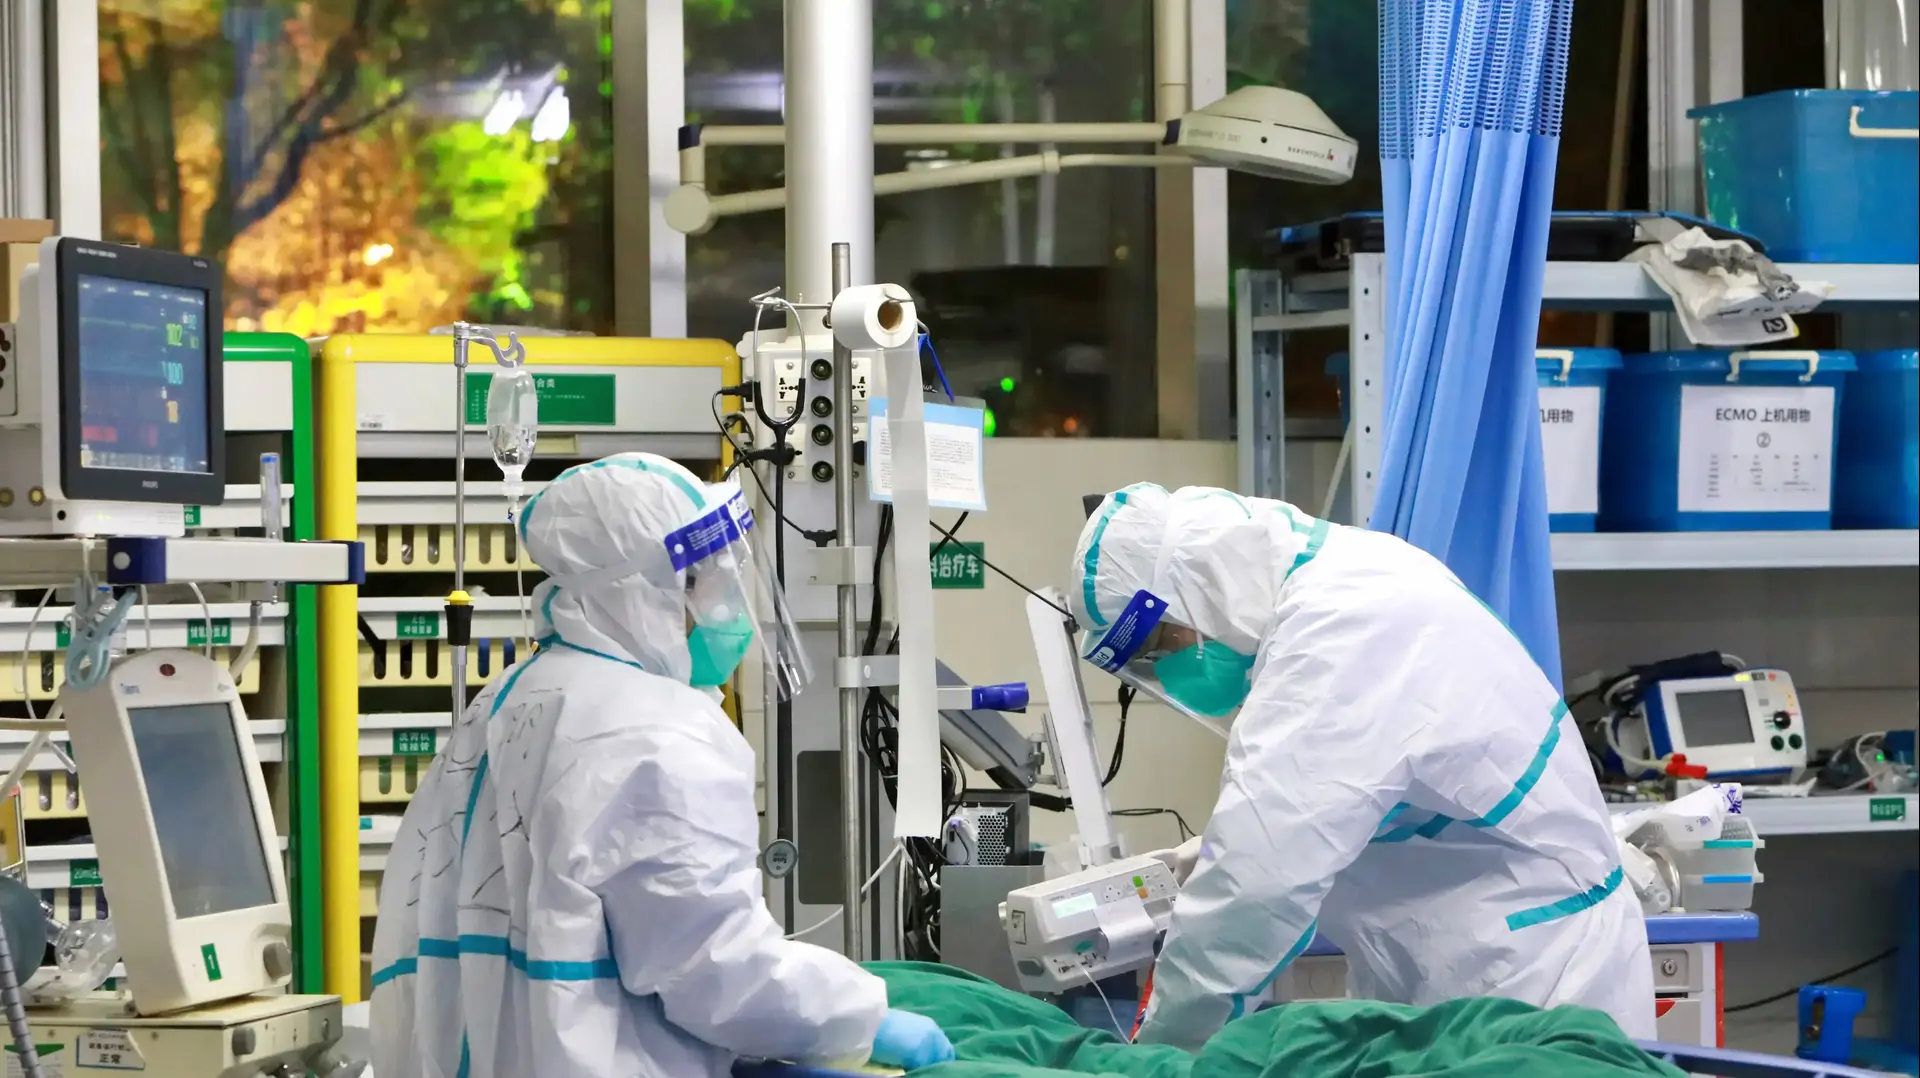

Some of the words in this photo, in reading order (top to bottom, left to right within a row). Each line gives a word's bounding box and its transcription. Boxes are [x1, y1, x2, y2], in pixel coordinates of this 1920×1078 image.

[535, 378, 555, 389] 合类
[1715, 408, 1757, 421] ECMO
[1760, 408, 1811, 423] 上机用物
[207, 954, 216, 970] 1
[99, 1053, 121, 1064] 正常
